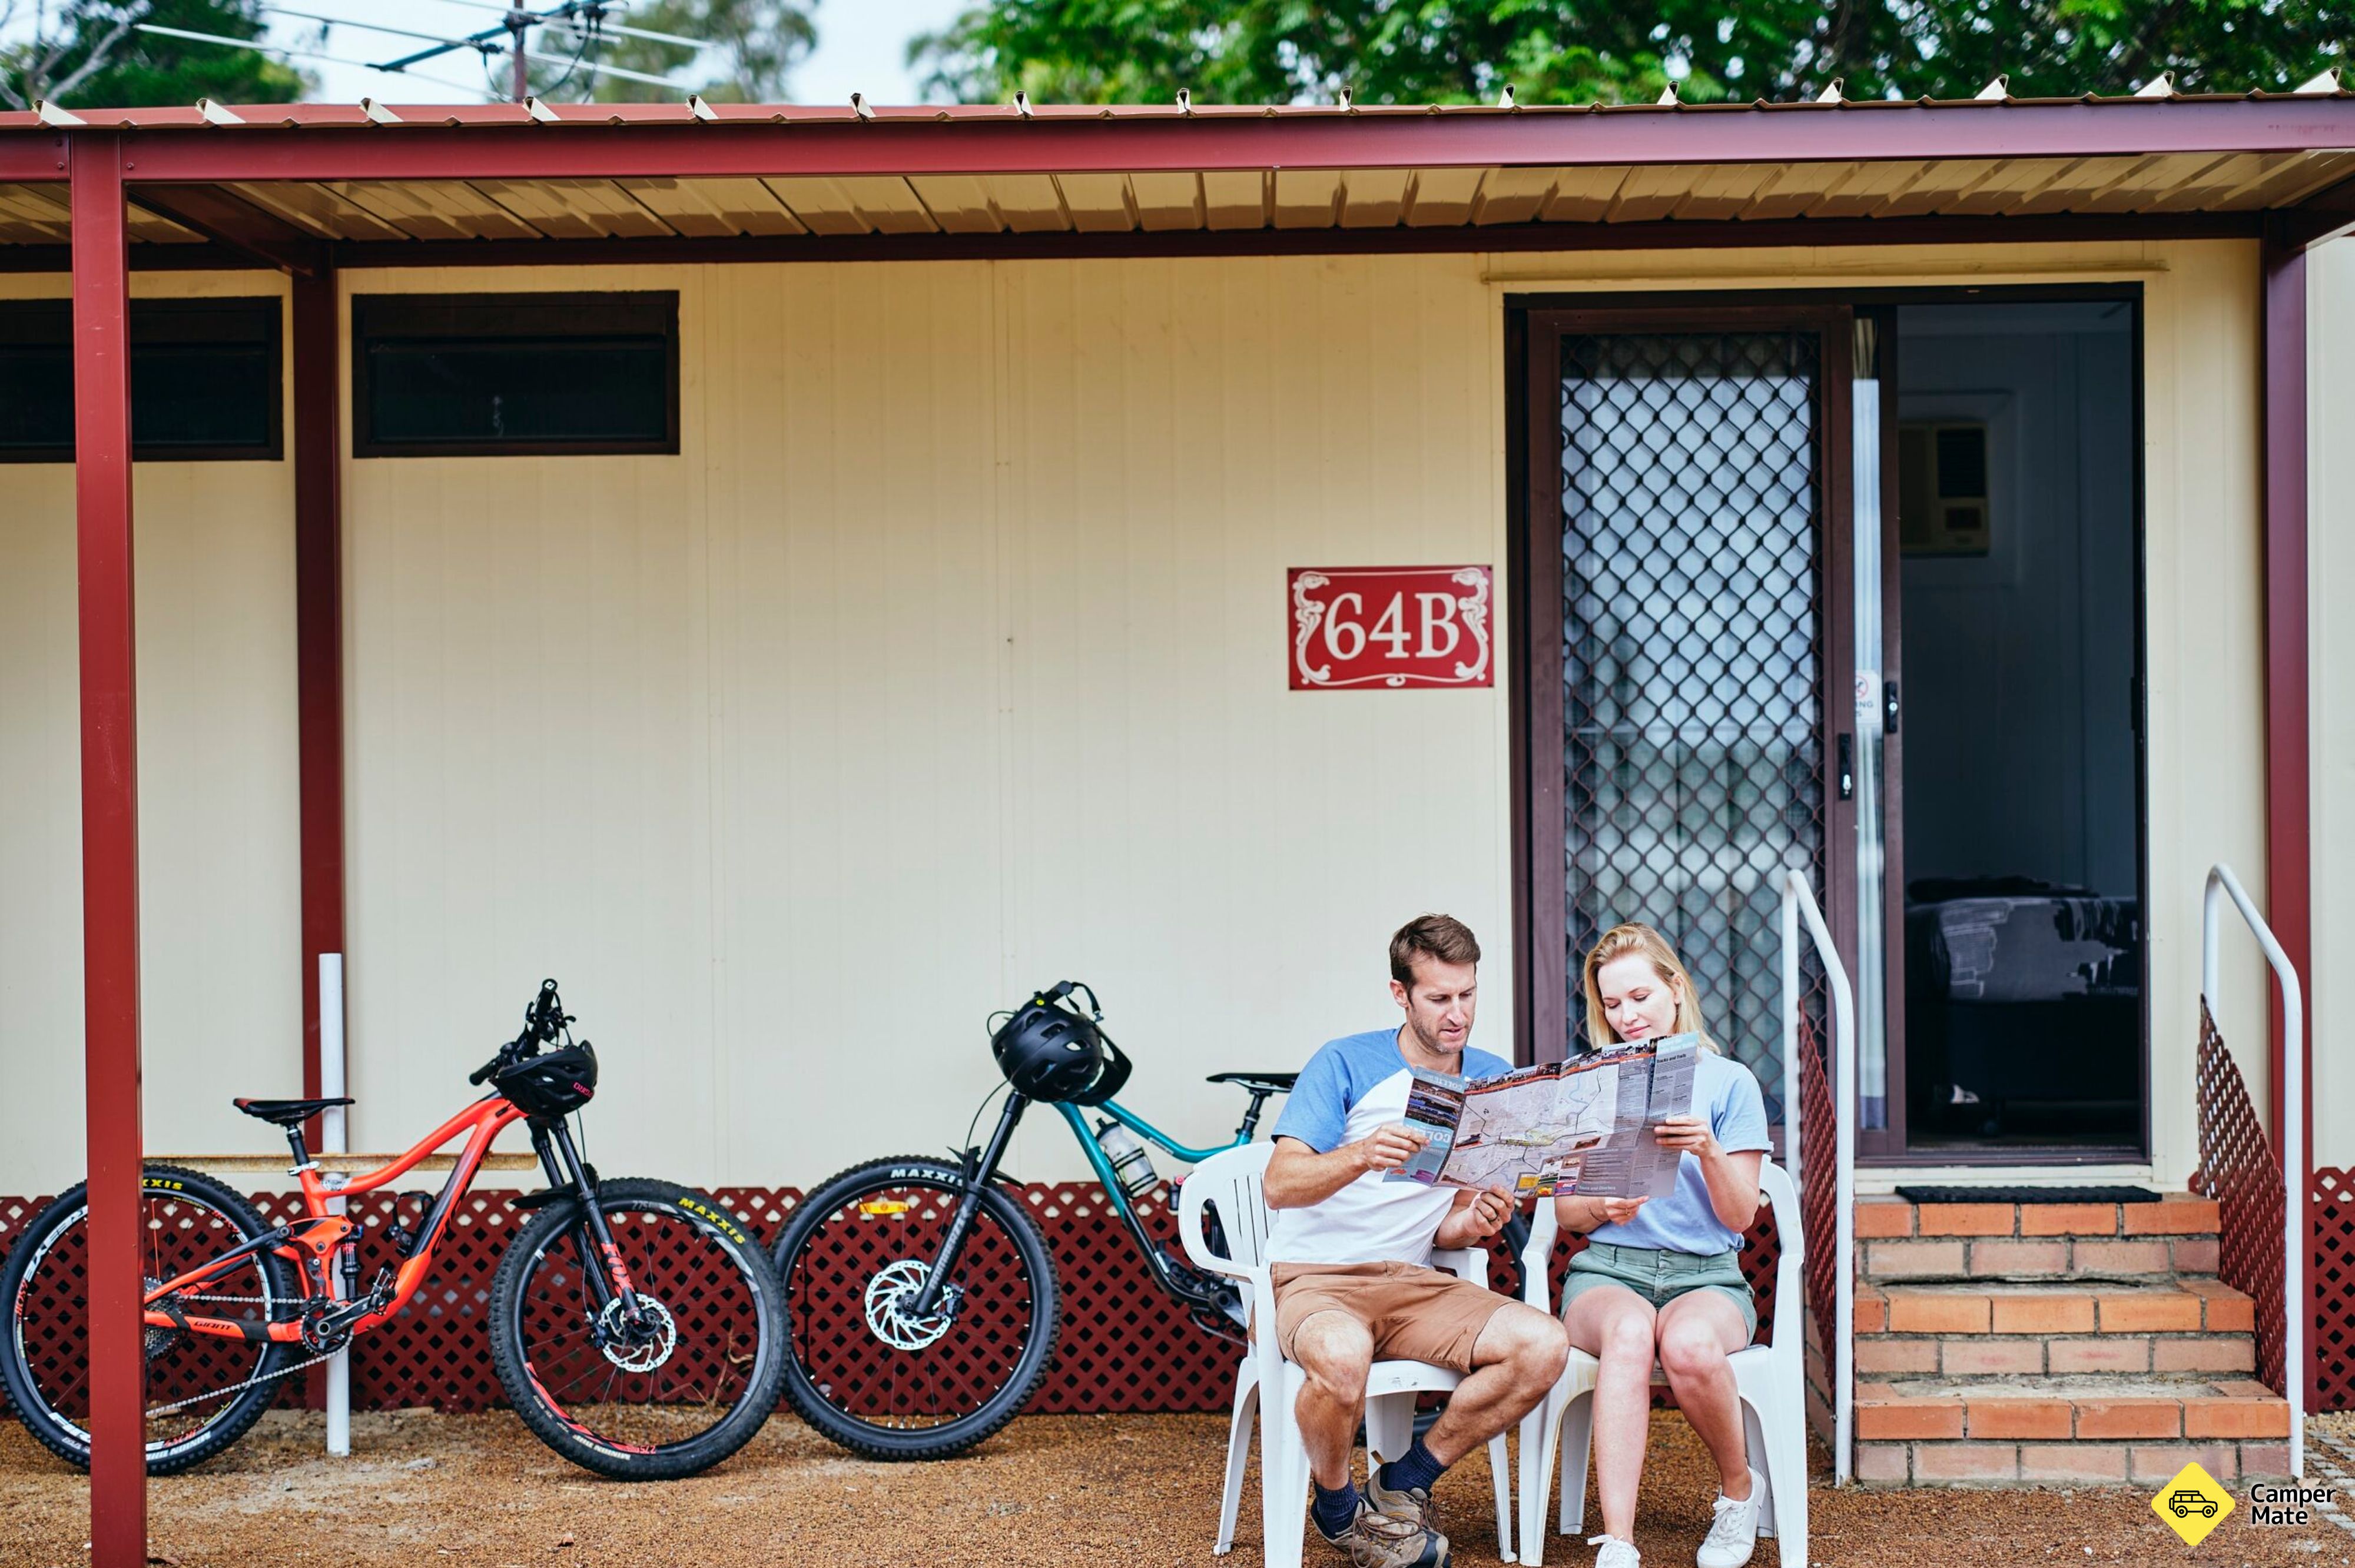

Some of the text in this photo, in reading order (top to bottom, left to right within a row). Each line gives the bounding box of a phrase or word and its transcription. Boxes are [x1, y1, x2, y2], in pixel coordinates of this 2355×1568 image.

[1324, 591, 1460, 660] 64B
[678, 1197, 745, 1244] MAXXIS
[601, 1243, 635, 1298] FOX
[194, 1321, 233, 1330] GIANT
